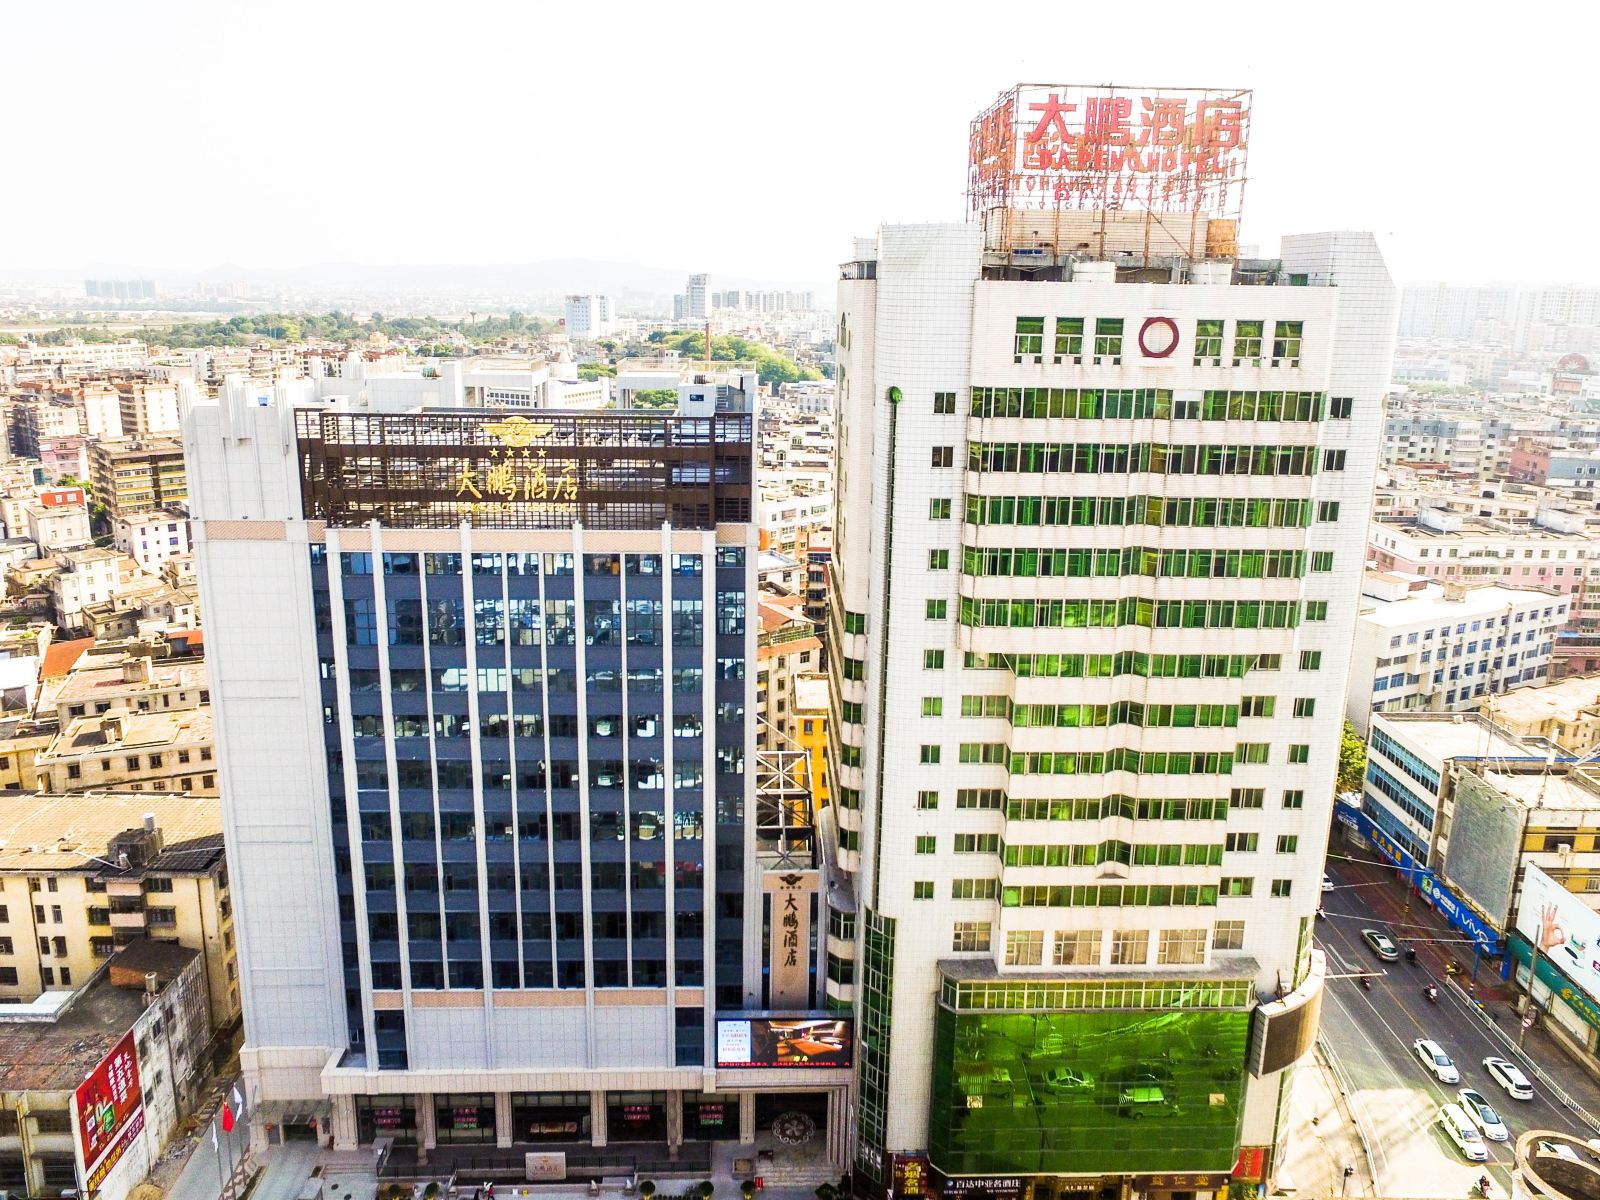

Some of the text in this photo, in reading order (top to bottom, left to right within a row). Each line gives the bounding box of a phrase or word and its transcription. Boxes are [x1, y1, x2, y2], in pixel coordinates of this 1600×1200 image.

[1028, 94, 1242, 148] 大鹏酒店
[456, 459, 578, 501] 大鹏酒店
[783, 893, 799, 967] 大鹏酒店
[1460, 912, 1488, 943] vivo
